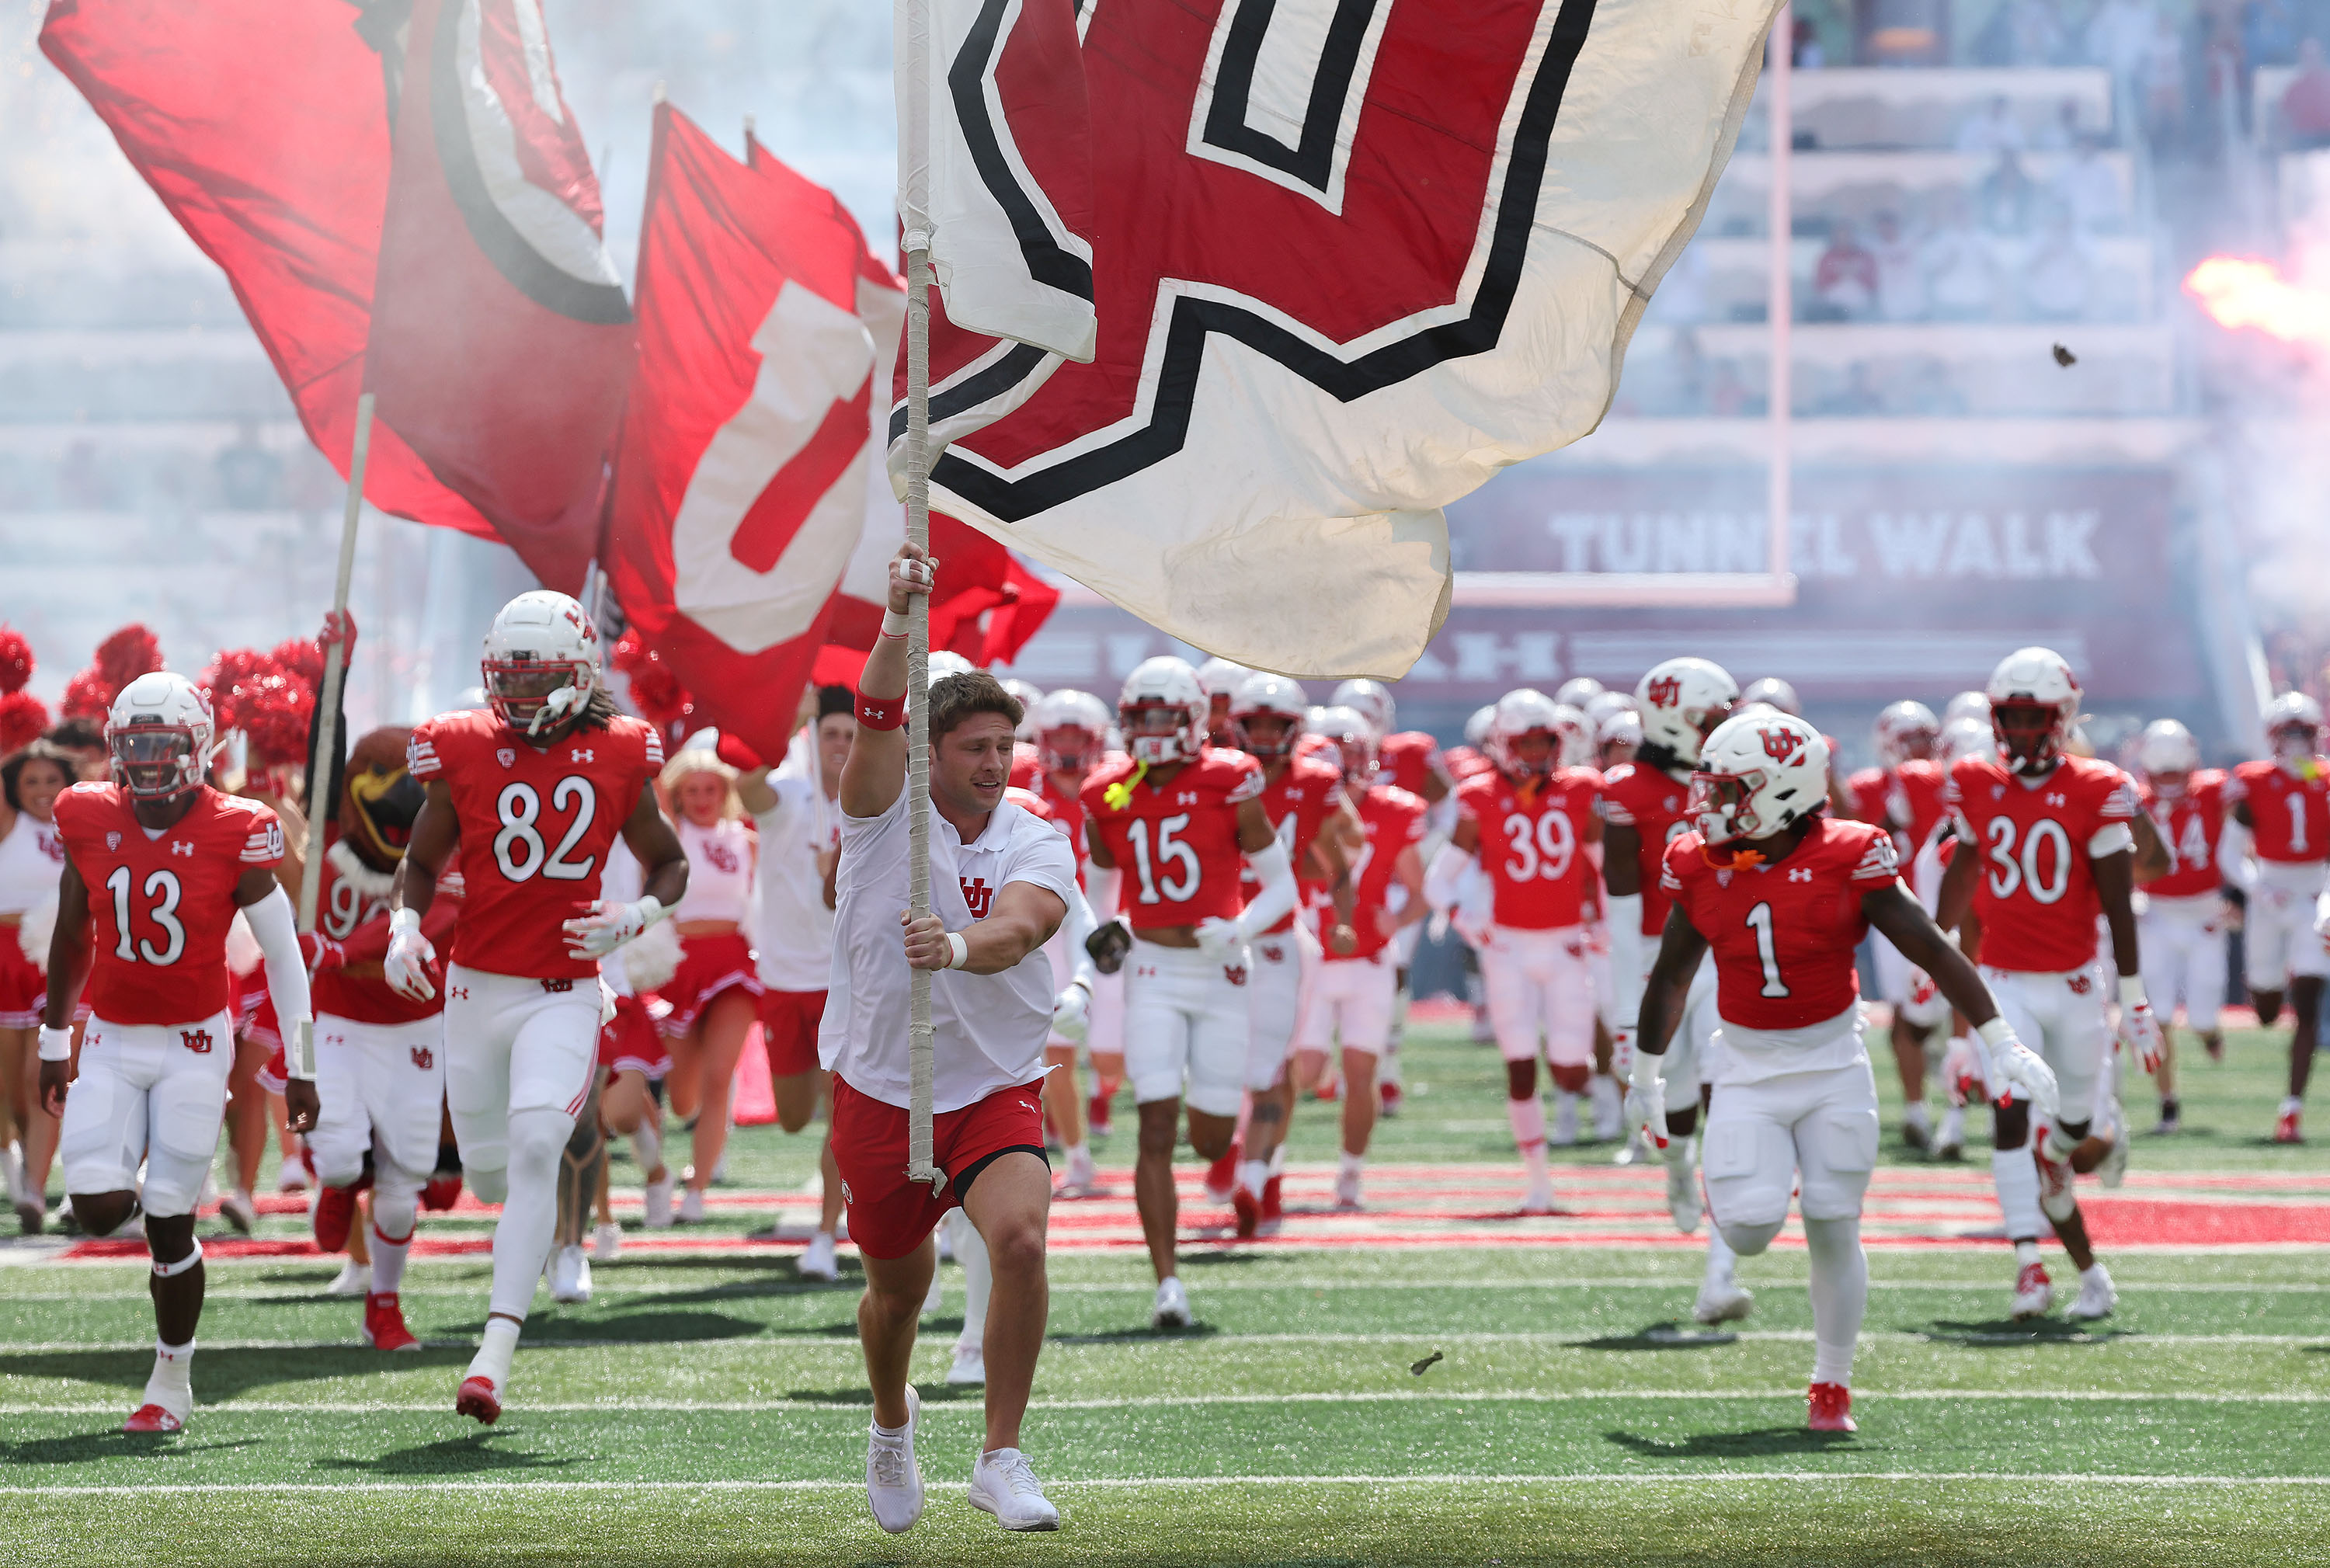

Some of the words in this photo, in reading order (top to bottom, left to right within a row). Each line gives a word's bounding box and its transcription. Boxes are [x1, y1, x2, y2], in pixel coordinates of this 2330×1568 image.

[1549, 512, 1857, 576] TUNNEL
[1869, 511, 2099, 579] WALK
[492, 775, 596, 882] 82
[1128, 812, 1202, 905] 15
[1503, 809, 1575, 882] 39
[1988, 815, 2072, 905] 30
[2284, 791, 2309, 853] 1
[106, 864, 186, 966] 13
[1746, 902, 1790, 998] 1
